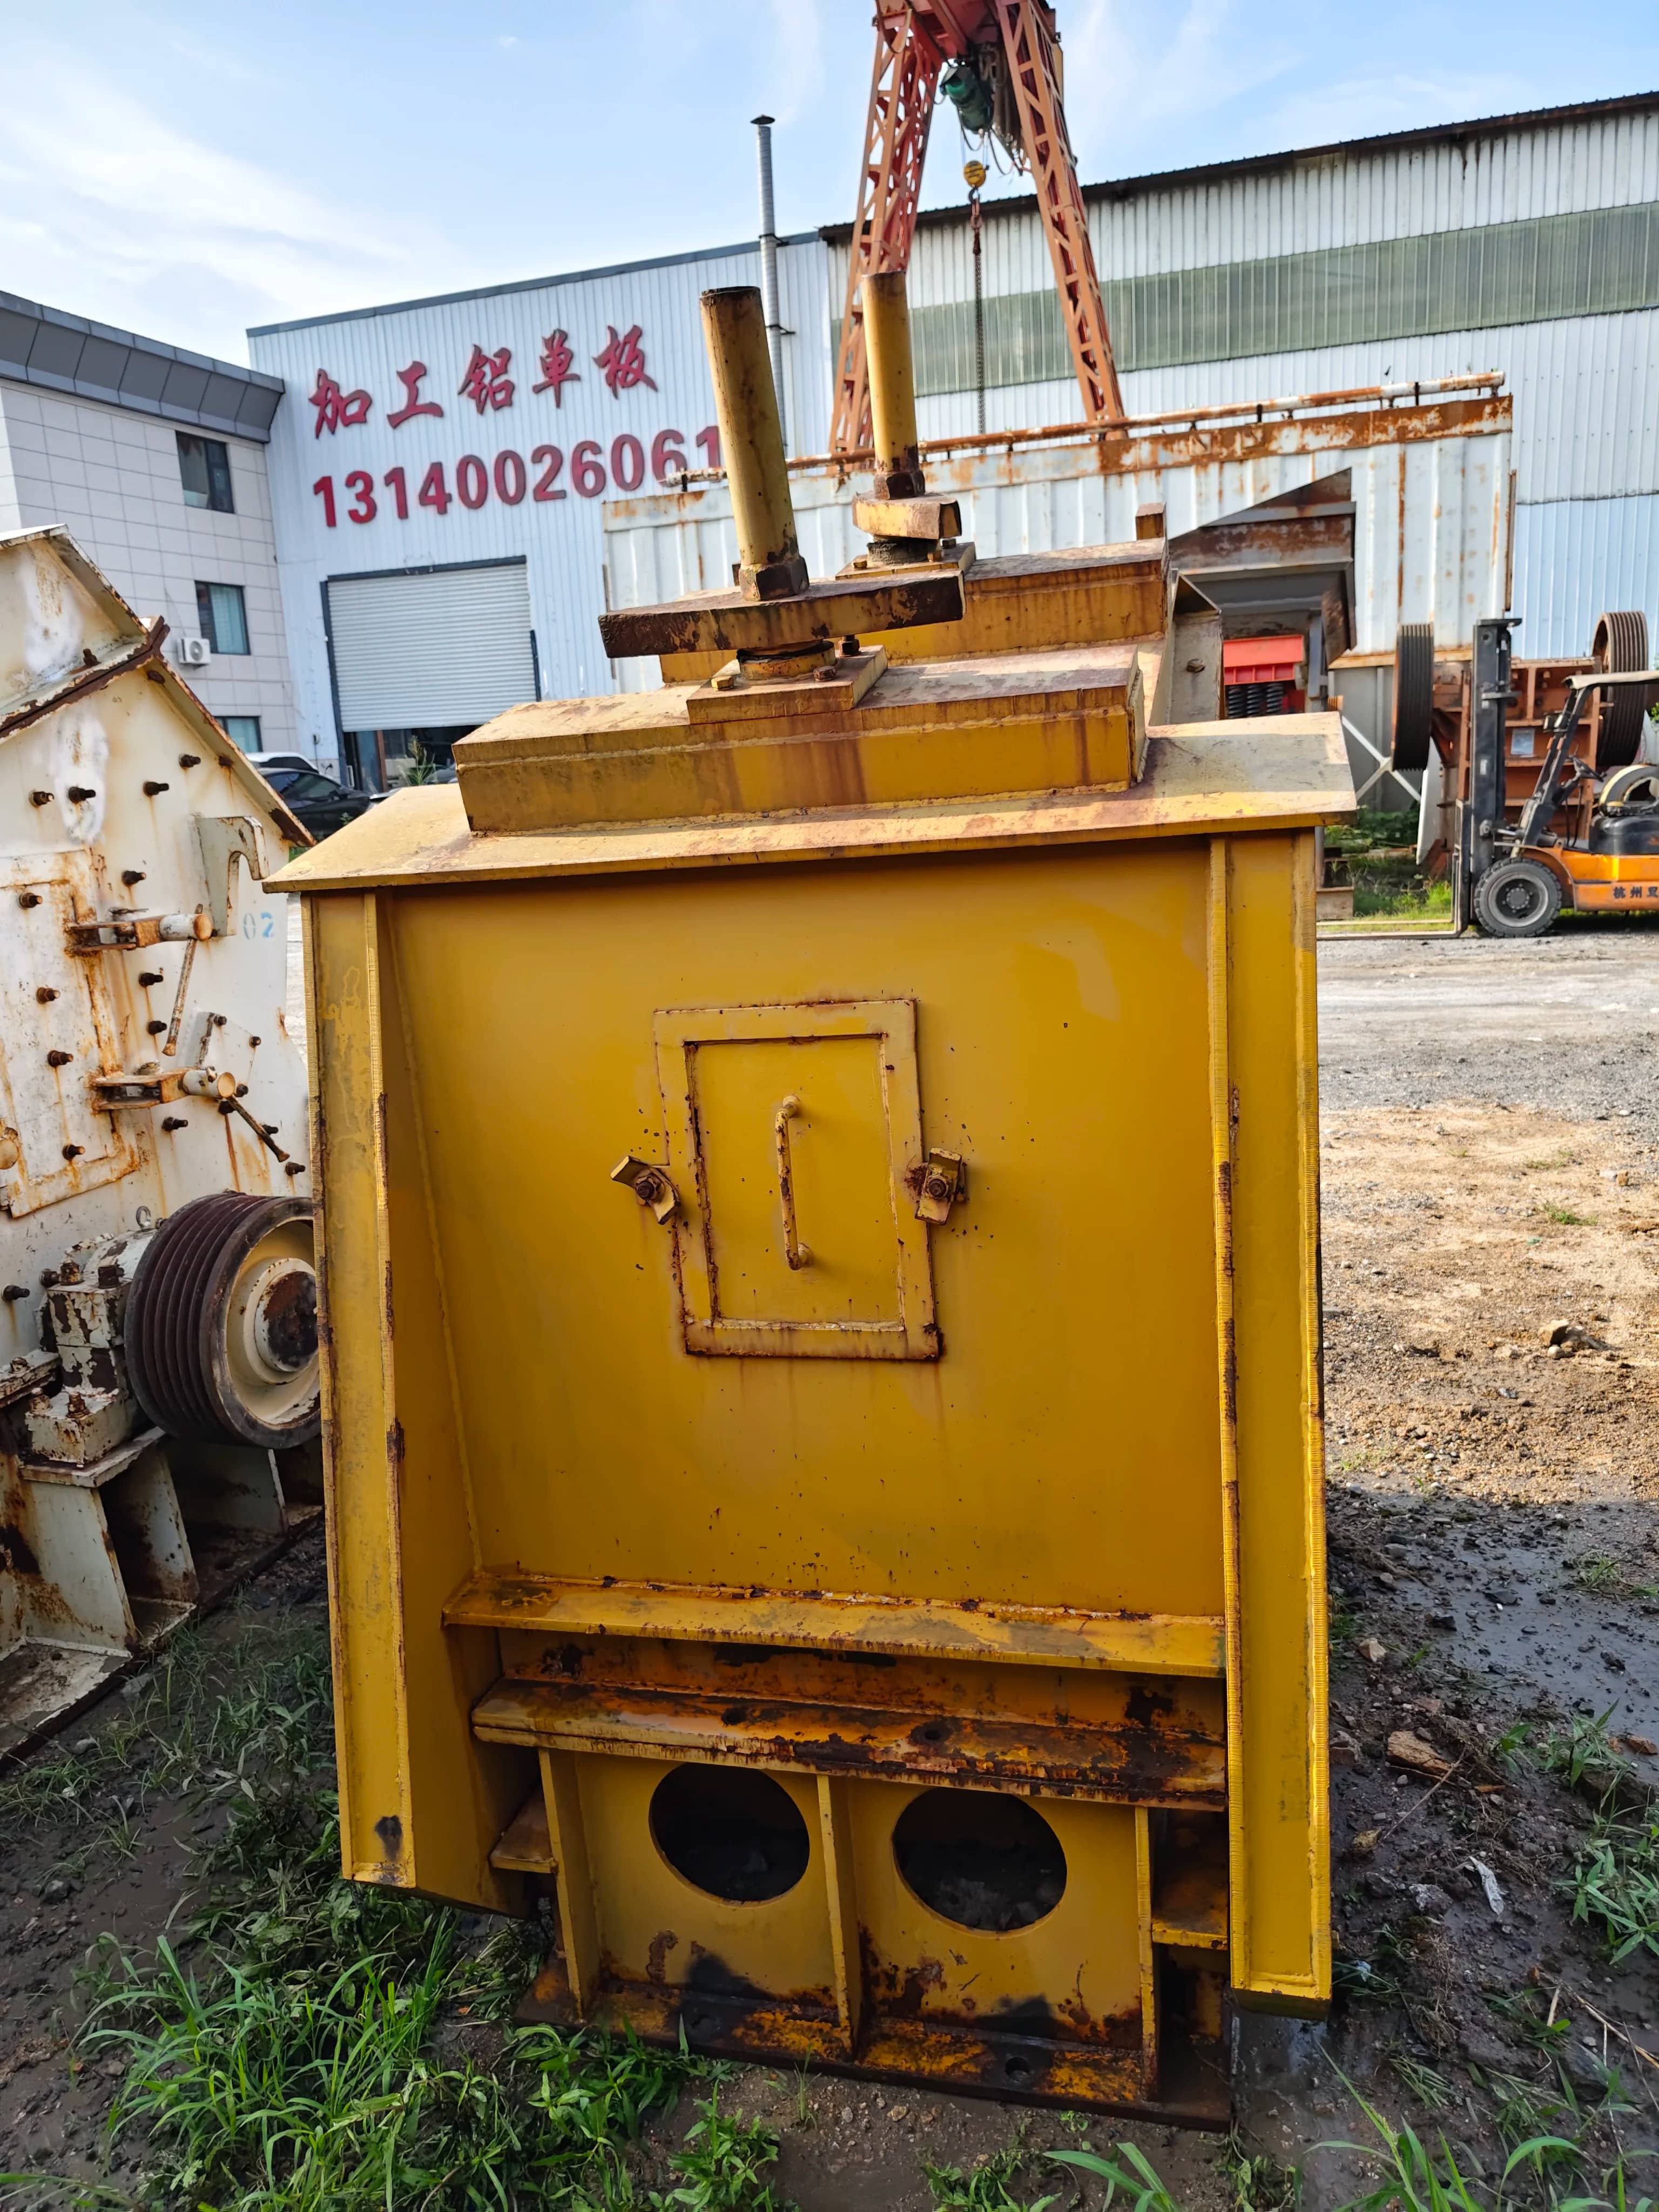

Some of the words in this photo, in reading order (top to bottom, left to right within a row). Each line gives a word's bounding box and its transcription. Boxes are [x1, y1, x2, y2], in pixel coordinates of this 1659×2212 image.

[309, 324, 658, 439] 加工铝单板
[313, 425, 720, 528] 13140026061
[243, 912, 274, 940] 02
